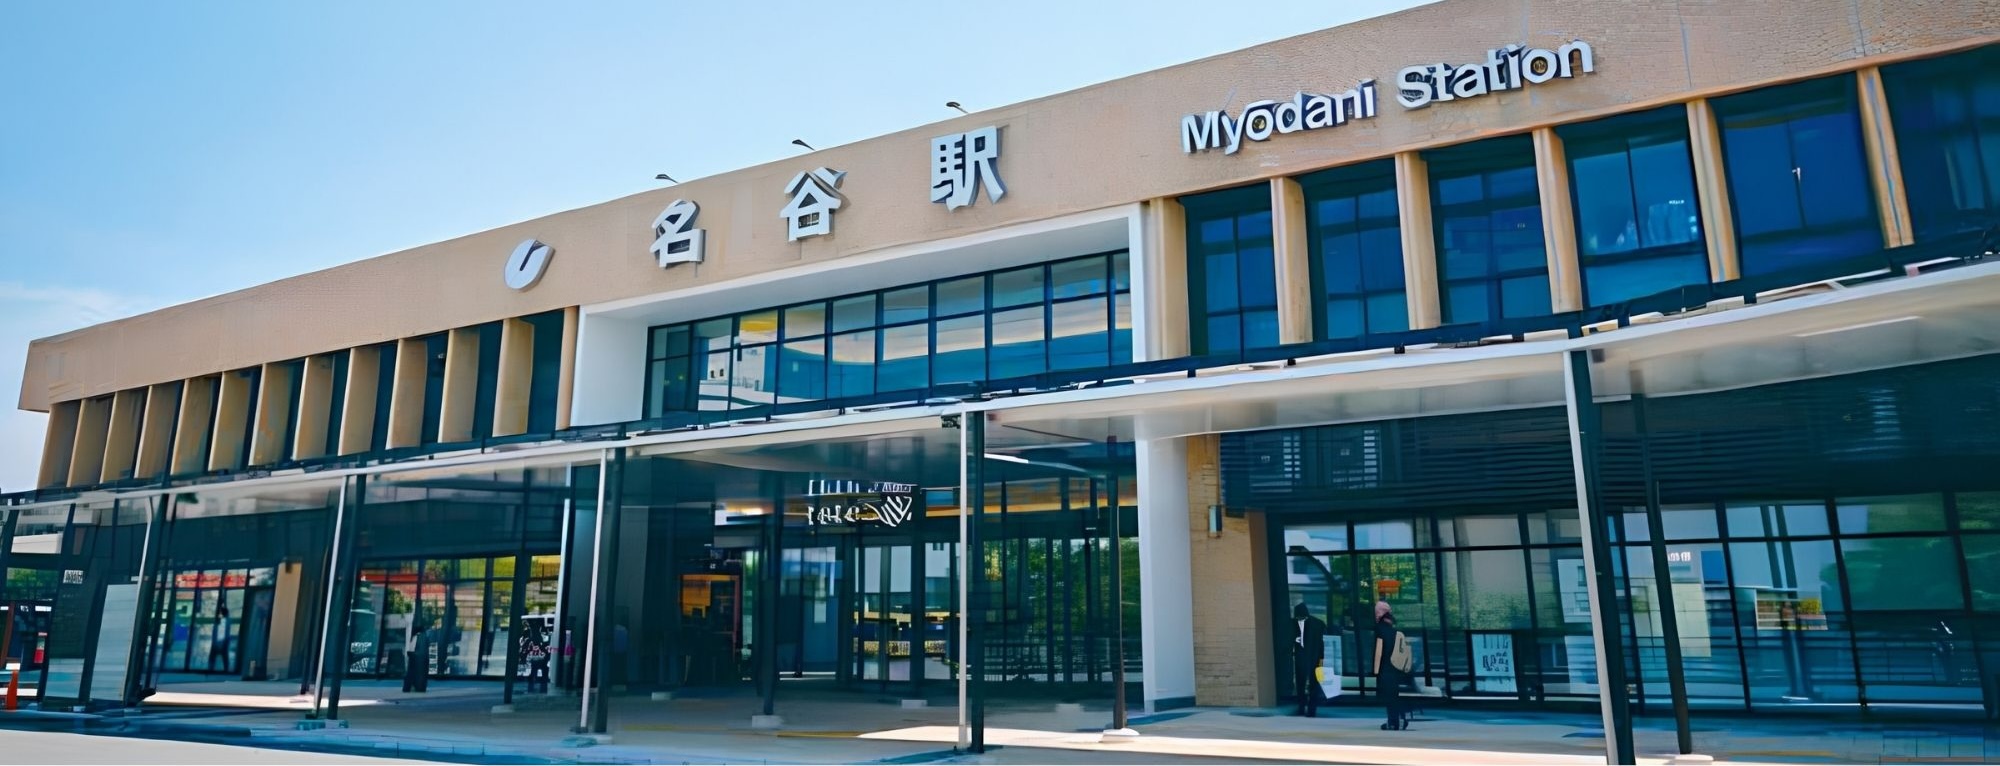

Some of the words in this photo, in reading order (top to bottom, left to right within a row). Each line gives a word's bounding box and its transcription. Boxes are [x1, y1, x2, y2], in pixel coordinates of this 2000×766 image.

[1397, 39, 1595, 111] Station
[650, 126, 1007, 268] 名谷駅
